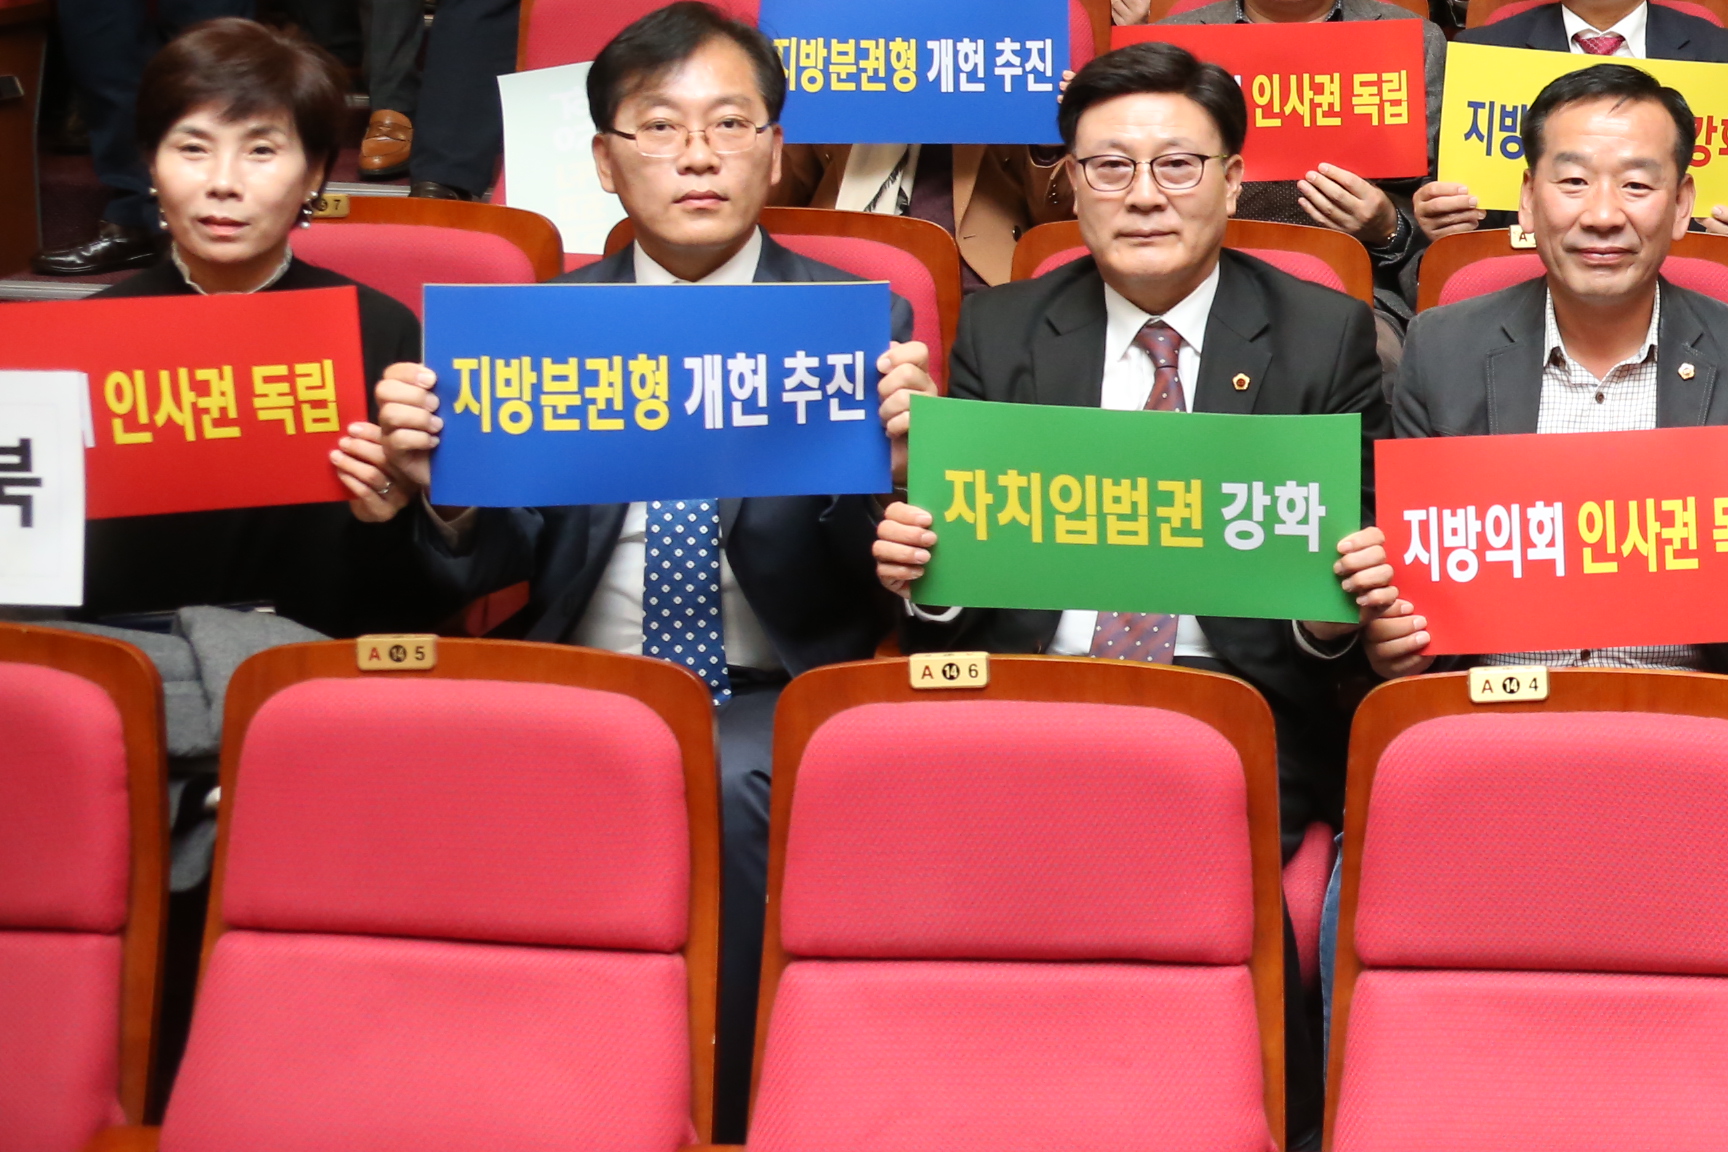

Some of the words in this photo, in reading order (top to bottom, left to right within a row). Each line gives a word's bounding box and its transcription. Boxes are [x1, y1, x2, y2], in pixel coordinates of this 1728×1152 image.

[927, 38, 984, 92] 개헌
[995, 38, 1052, 92] 추진
[1253, 73, 1341, 127] 인사권
[1352, 70, 1408, 125] 독립
[1465, 102, 1527, 159] 지방
[105, 366, 240, 444] 인사권
[252, 360, 339, 434] 독립
[455, 356, 669, 433] 지방분권형
[684, 353, 767, 429] 개헌
[783, 351, 865, 423] 추진
[945, 470, 1203, 547] 자치입법권
[1222, 481, 1325, 552] 강화
[1404, 501, 1565, 582] 지방의회
[1578, 496, 1699, 573] 인사권
[368, 647, 381, 661] A
[414, 646, 425, 660] 5
[921, 665, 934, 679] A
[968, 664, 978, 678] 6
[1481, 680, 1494, 694] A
[1529, 677, 1538, 691] 4
